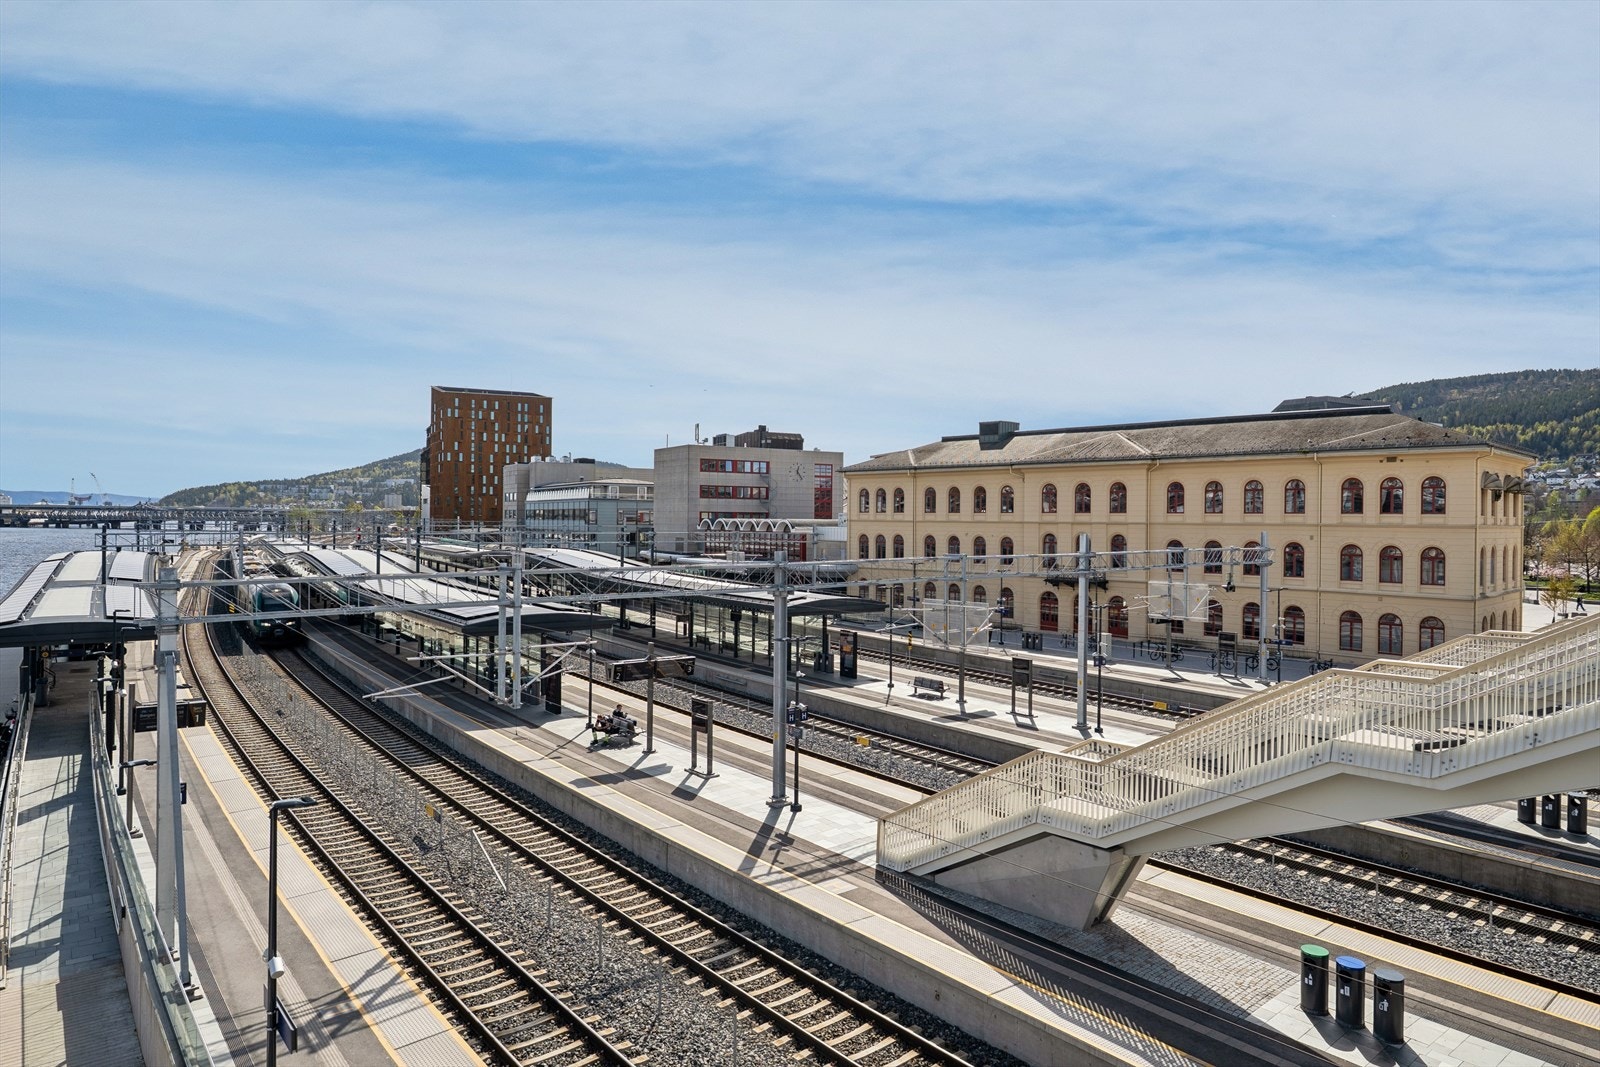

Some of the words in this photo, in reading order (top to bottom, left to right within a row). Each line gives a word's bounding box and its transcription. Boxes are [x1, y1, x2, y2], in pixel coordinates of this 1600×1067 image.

[616, 672, 621, 680] 2
[195, 714, 199, 723] 1
[789, 714, 794, 722] H
[801, 712, 807, 720] H
